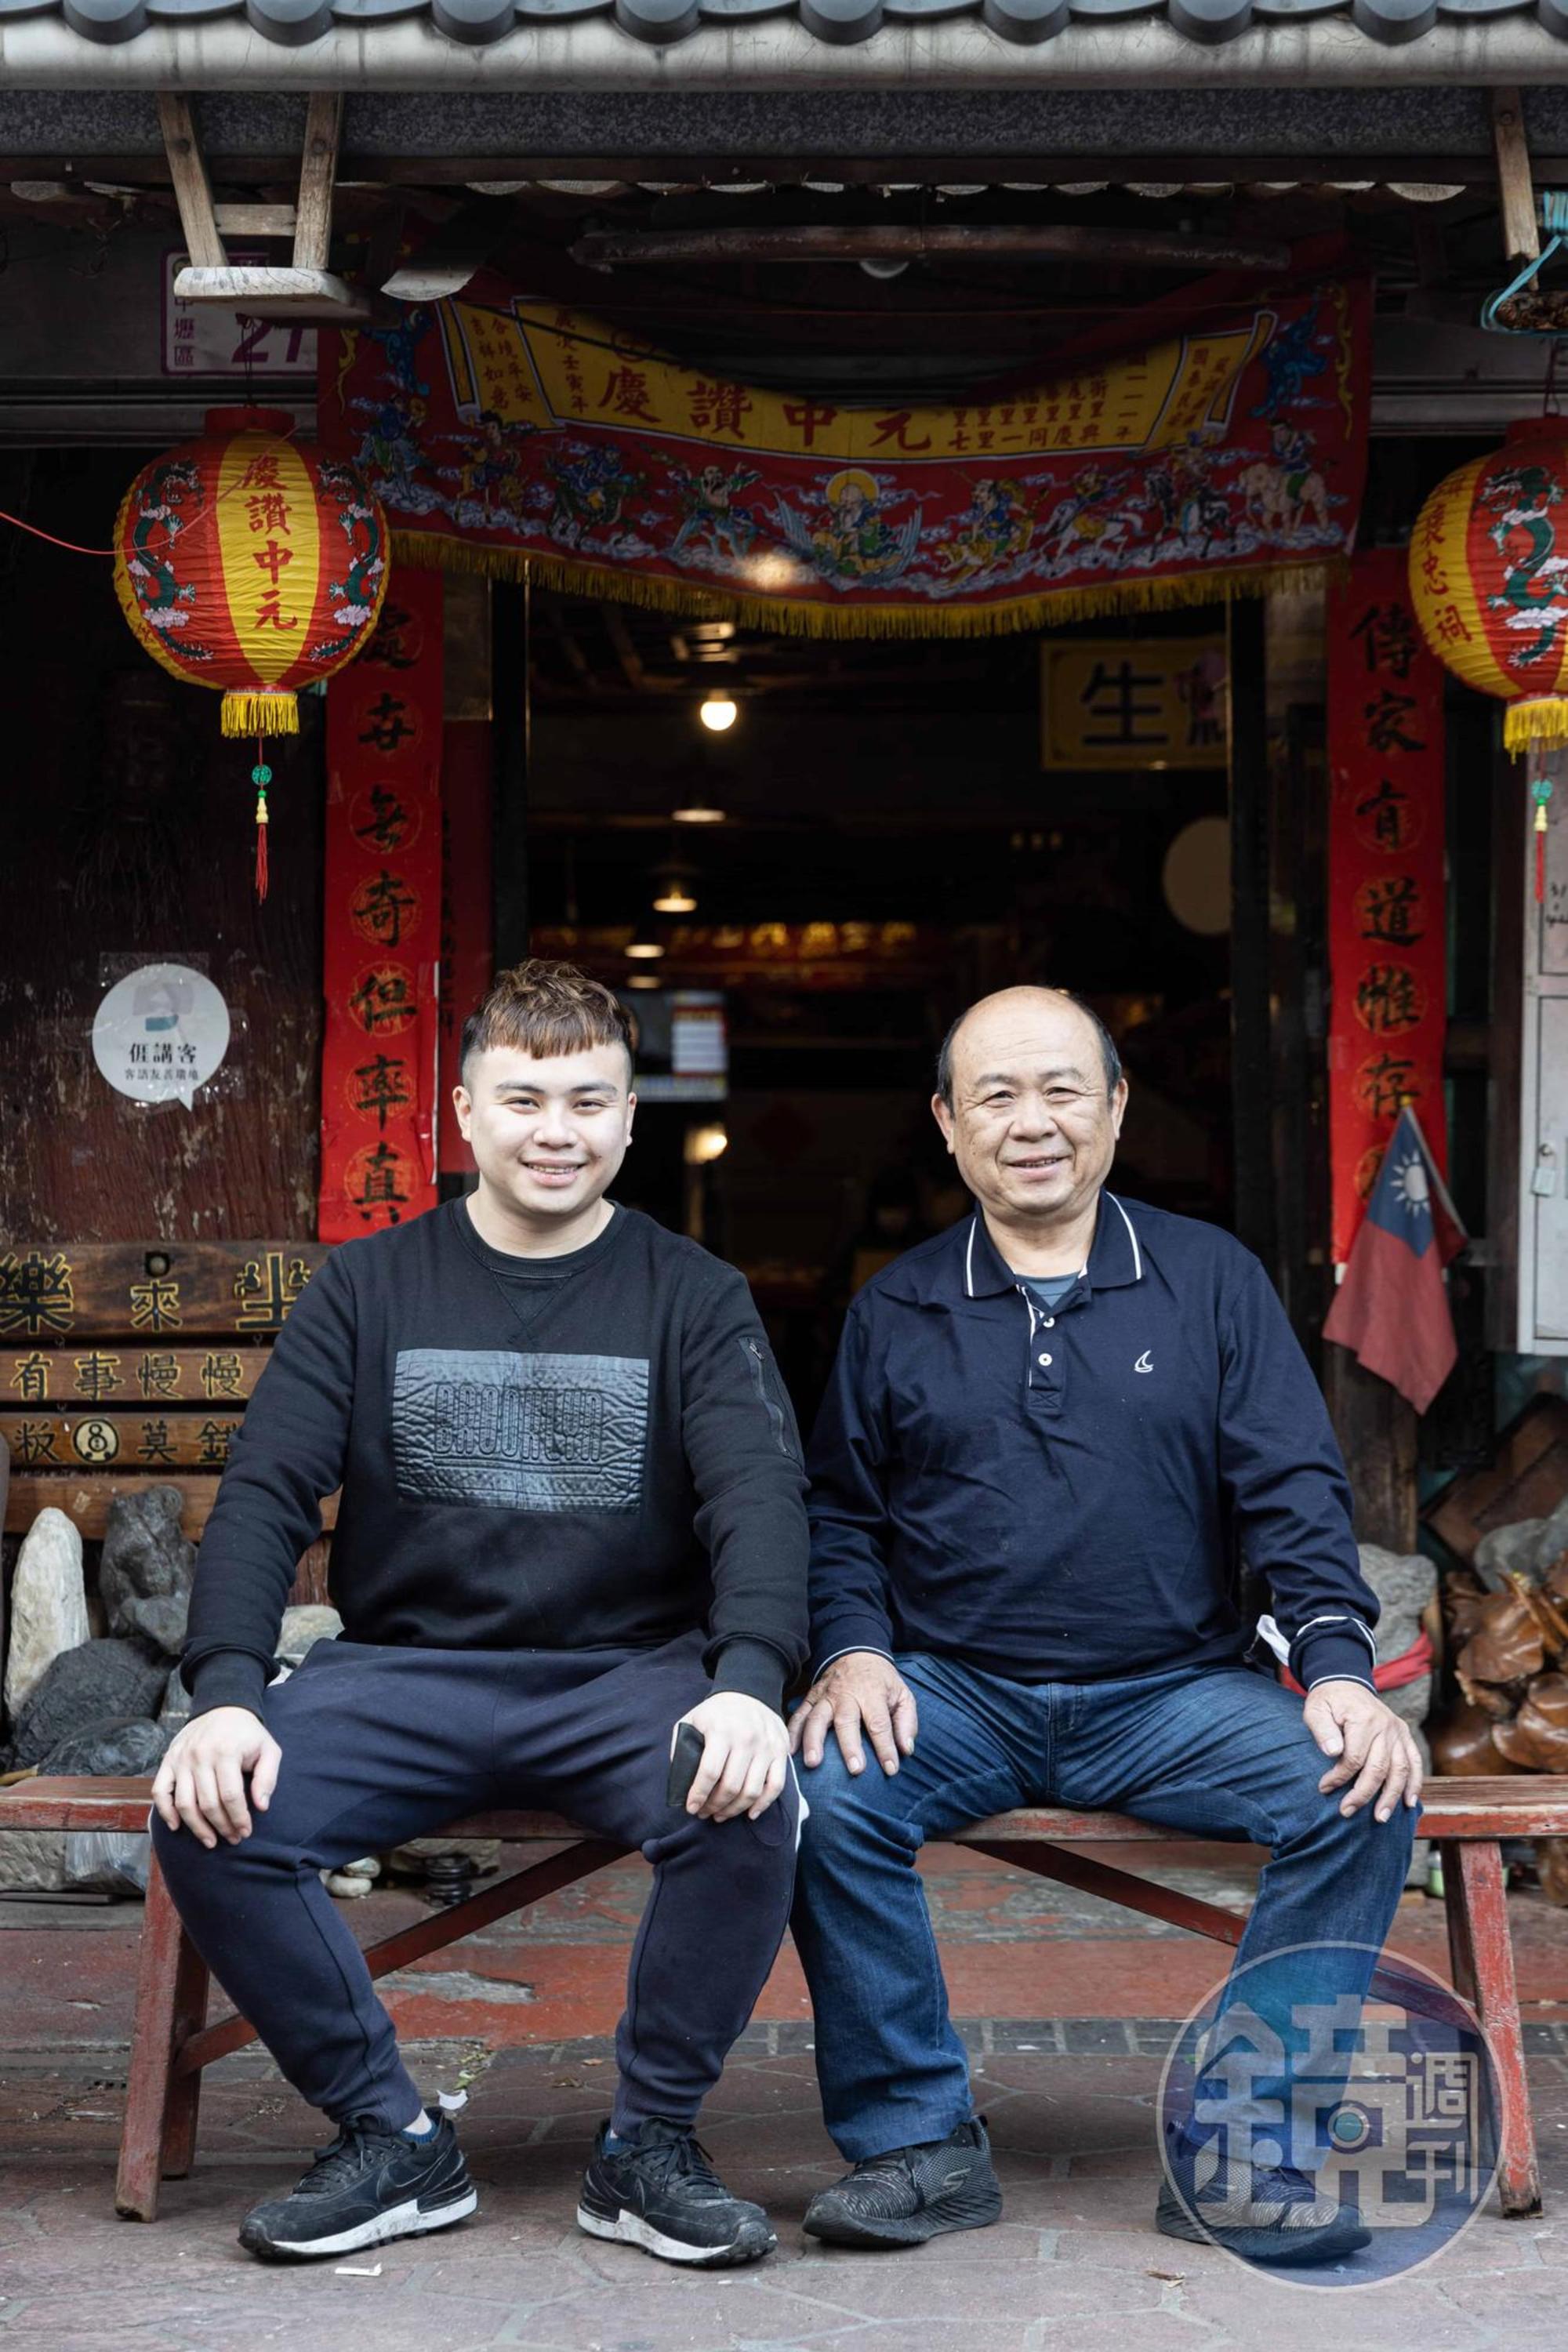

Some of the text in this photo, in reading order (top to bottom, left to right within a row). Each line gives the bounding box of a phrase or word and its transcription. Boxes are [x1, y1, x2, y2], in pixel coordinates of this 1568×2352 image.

[470, 316, 509, 409] 吉祥如意
[492, 317, 533, 402] 合境平安
[598, 365, 932, 451] 慶讚中元
[242, 453, 298, 630] 慶讚中元
[1350, 604, 1428, 1193] 傳家有道惟存
[10, 1352, 248, 1400] 有事慢慢
